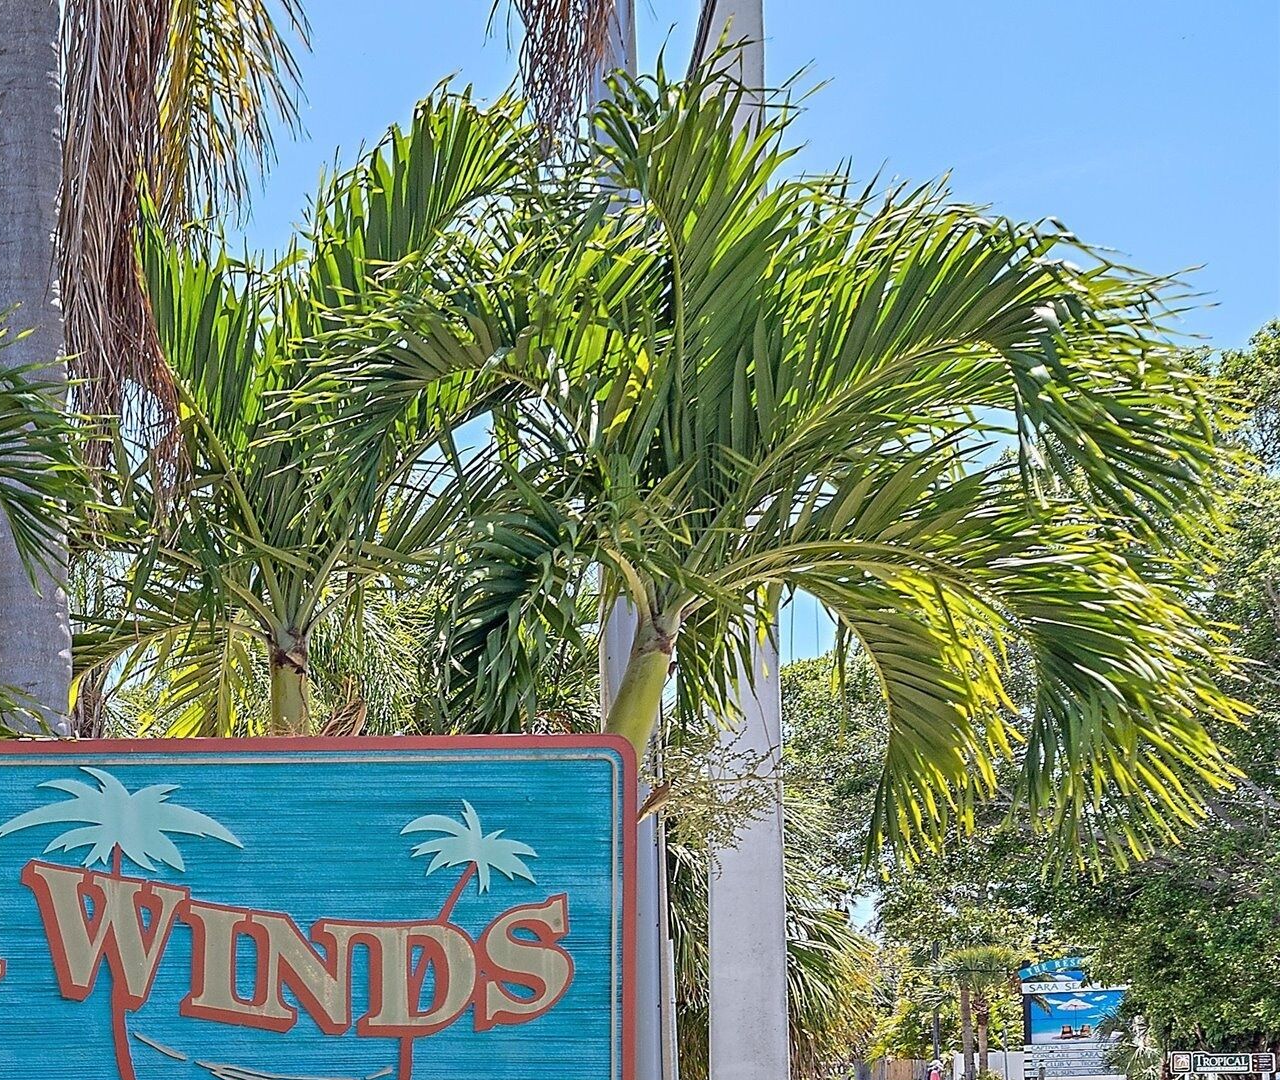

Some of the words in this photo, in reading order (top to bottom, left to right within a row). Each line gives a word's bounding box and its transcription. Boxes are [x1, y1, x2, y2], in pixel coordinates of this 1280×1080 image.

[20, 858, 576, 1038] WINDS
[1026, 963, 1048, 975] THE
[1028, 983, 1059, 993] SARA
[1194, 1054, 1249, 1066] TROPICAL
